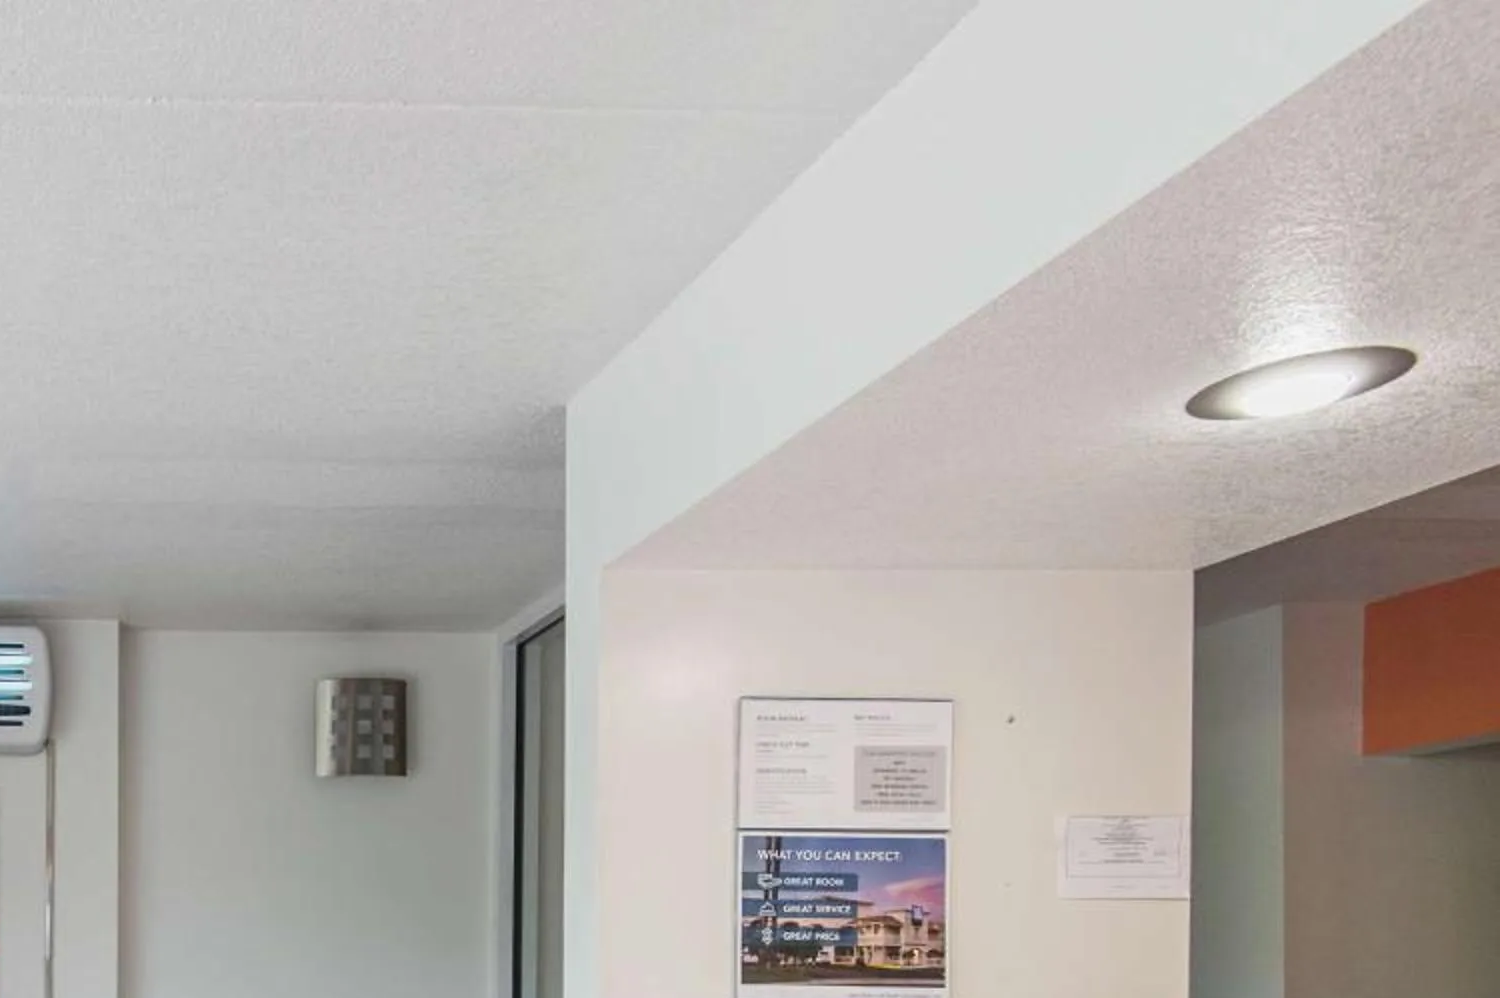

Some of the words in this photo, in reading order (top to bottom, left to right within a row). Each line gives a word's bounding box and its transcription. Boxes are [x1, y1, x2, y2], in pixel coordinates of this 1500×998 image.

[756, 850, 792, 861] WHAT
[796, 850, 821, 861] YOU
[825, 850, 851, 861] CAN
[783, 877, 813, 886] GREAT
[816, 877, 844, 886] ROOM
[783, 905, 813, 913] GREAT
[815, 905, 851, 913] SERVICE
[783, 932, 812, 940] GREAT
